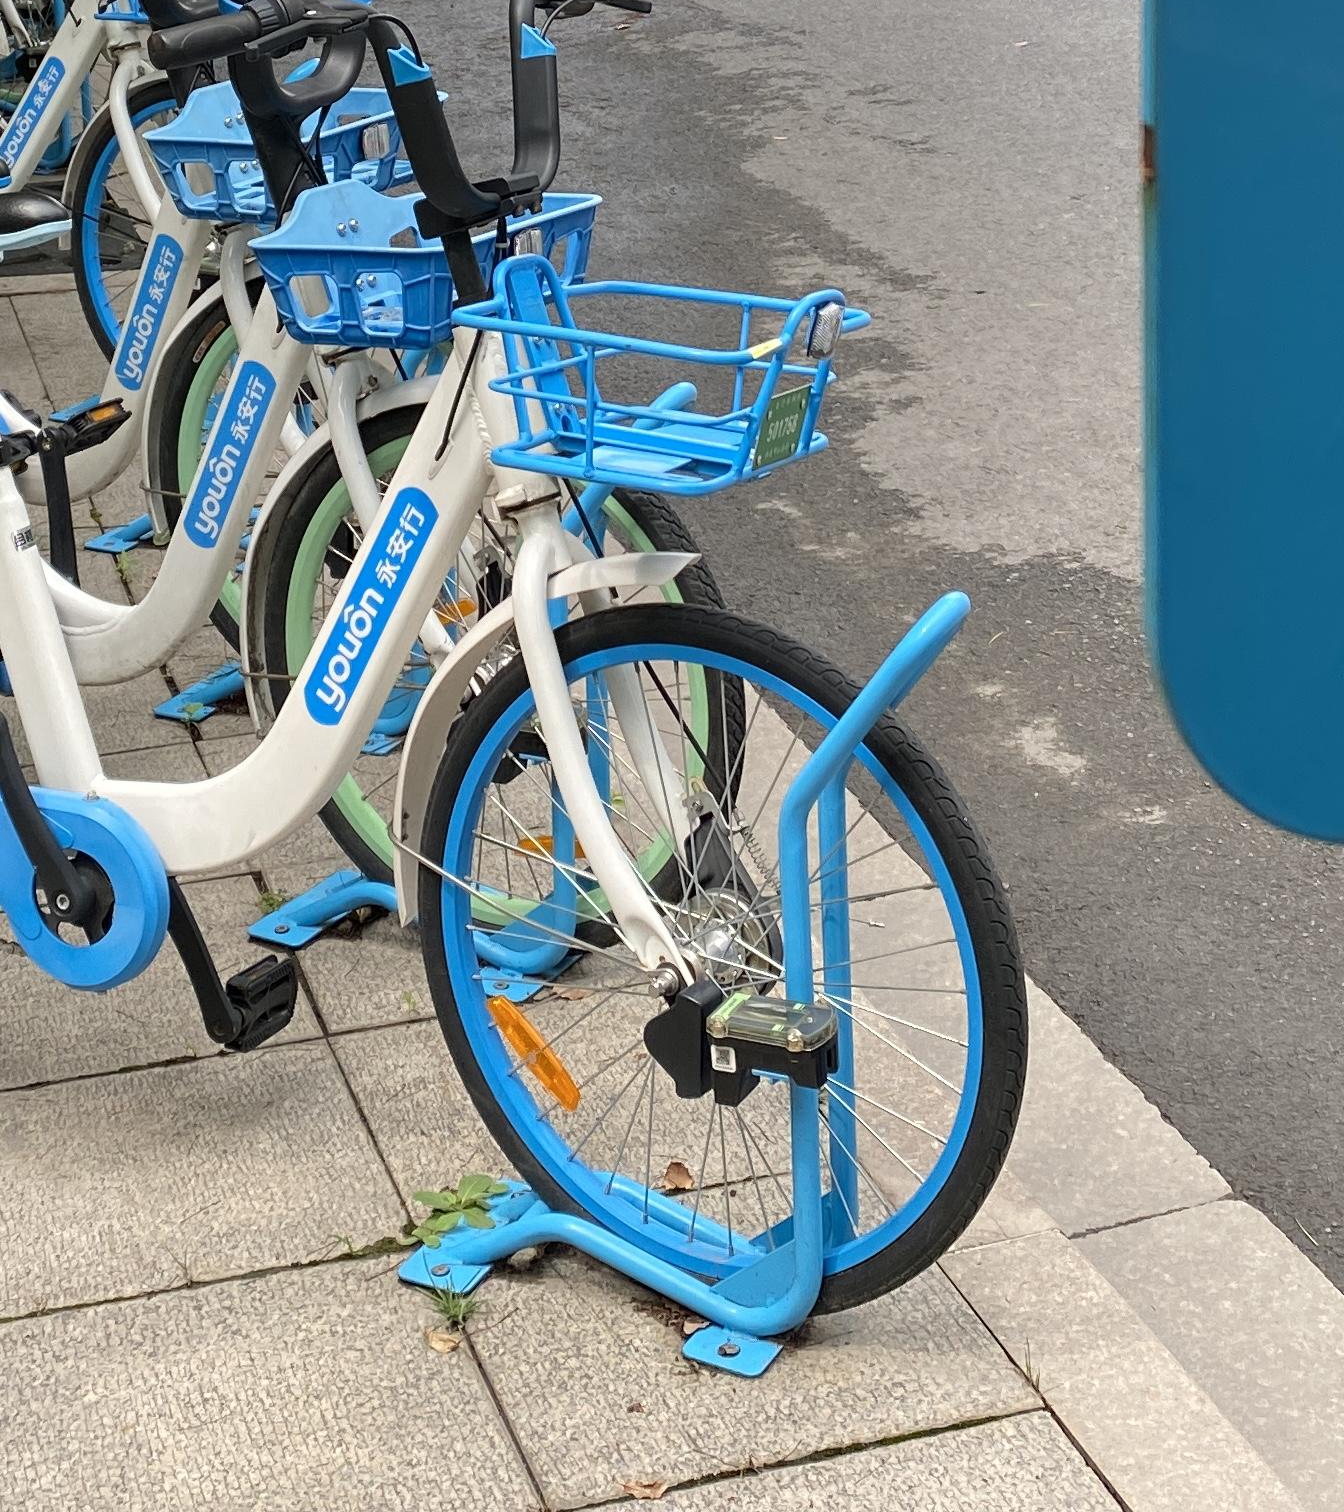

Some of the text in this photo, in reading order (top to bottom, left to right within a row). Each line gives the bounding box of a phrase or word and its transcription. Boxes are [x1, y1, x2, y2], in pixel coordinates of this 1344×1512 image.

[149, 245, 176, 305] 永安行
[230, 374, 266, 445] 永安行
[315, 502, 426, 713] youôn 永安行
